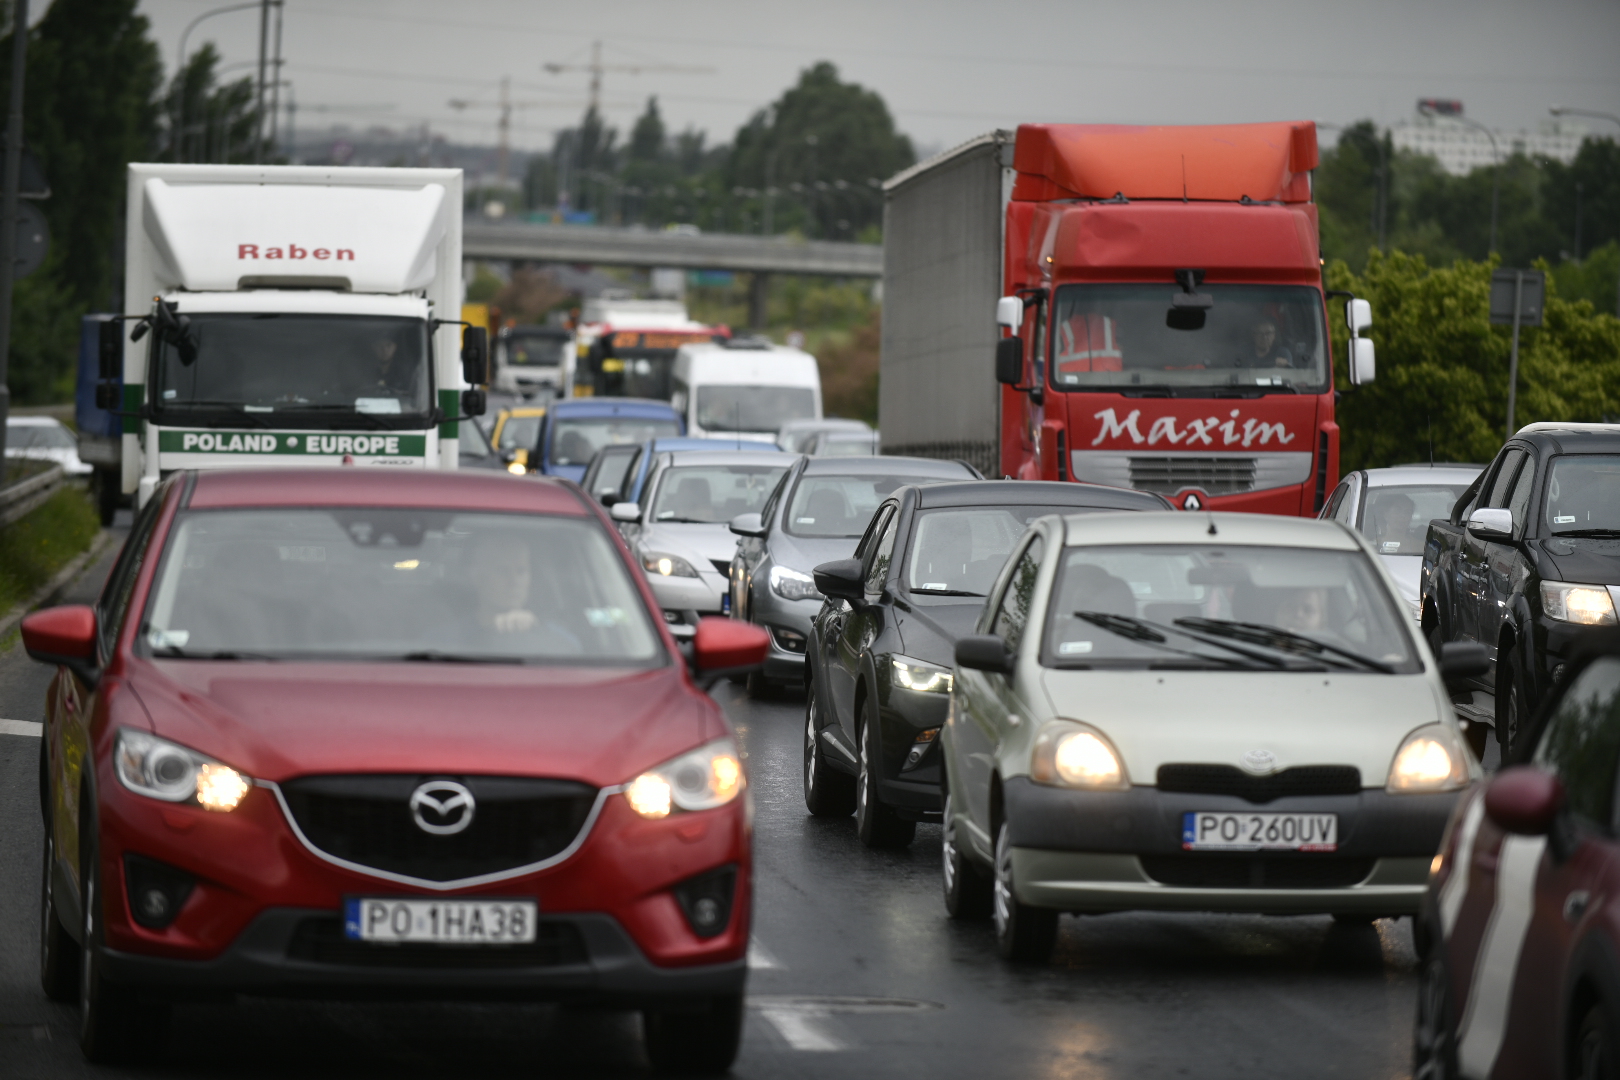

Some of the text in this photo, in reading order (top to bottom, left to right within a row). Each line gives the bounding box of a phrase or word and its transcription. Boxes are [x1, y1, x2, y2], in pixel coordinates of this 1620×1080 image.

[238, 243, 355, 261] Raben
[1091, 407, 1295, 448] Maxim
[183, 433, 400, 454] POLAND EUROPE
[1201, 815, 1333, 843] PO 260UV
[367, 901, 527, 938] PO 1HA38
